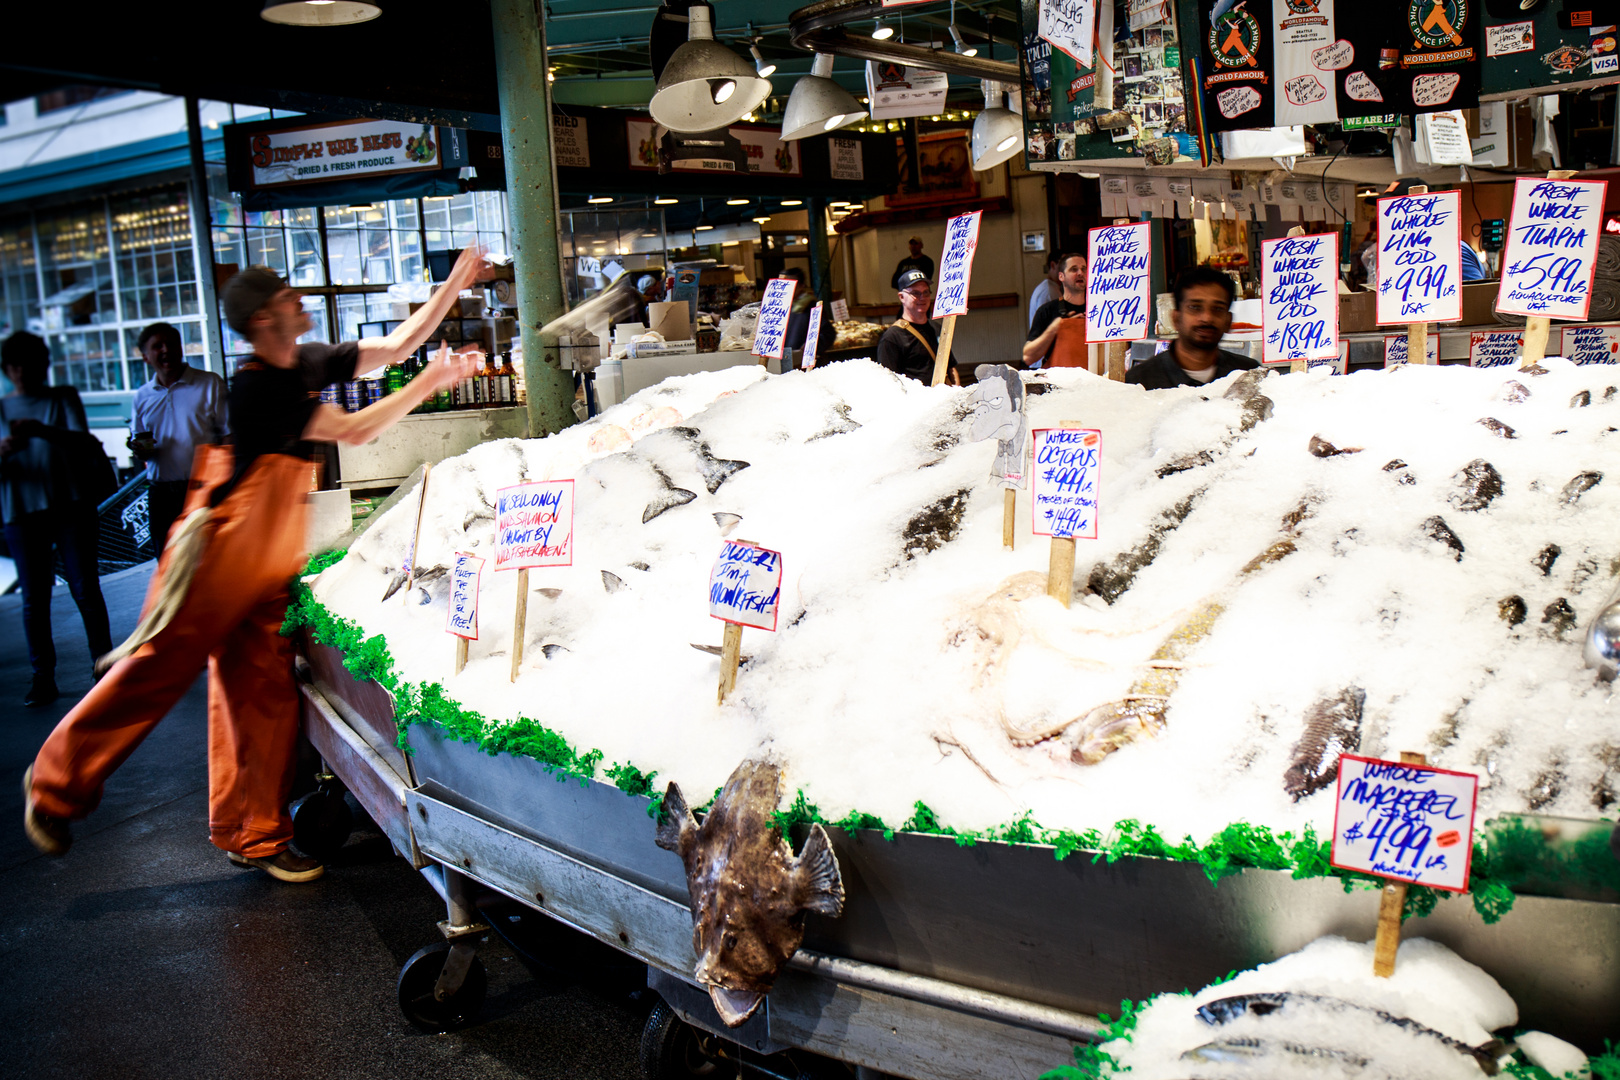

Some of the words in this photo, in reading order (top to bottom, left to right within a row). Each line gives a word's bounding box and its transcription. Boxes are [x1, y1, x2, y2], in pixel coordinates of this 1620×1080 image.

[1410, 5, 1418, 27] PIKE
[1414, 28, 1436, 46] PLACE
[1438, 30, 1456, 45] FISH
[1214, 49, 1234, 66] PLACE
[1236, 53, 1251, 65] FISH
[1248, 19, 1259, 53] MARKET
[1404, 54, 1435, 63] WORLD
[1436, 49, 1471, 60] FAMOUS
[1594, 58, 1618, 70] VISA
[1072, 76, 1092, 90] WORLD
[1208, 73, 1233, 82] WORLD
[1234, 71, 1264, 79] FAMOUS
[554, 116, 578, 128] RIED
[1346, 117, 1359, 125] WE
[1360, 115, 1383, 124] ARE
[1384, 113, 1395, 123] 12
[326, 138, 359, 157] THE
[362, 132, 403, 152] BEST
[555, 137, 577, 146] PPLES
[834, 138, 857, 149] FRESH
[298, 164, 321, 175] DRIED
[323, 164, 329, 172] &
[330, 162, 356, 172] FRESH
[357, 156, 395, 168] PRODUCE
[557, 156, 587, 166] ETABLES
[703, 161, 719, 169] DRIED
[1529, 182, 1590, 201] FRESH
[1384, 196, 1446, 217] FRESH
[1528, 202, 1590, 219] WHOLE
[950, 216, 973, 231] FRESH
[1391, 211, 1453, 231] WHOLE
[951, 228, 972, 240] WHOLE
[1095, 226, 1138, 243] FRESH
[1382, 229, 1432, 252] LING
[1515, 221, 1588, 248] TILAPIA
[951, 239, 966, 251] WILD
[1097, 241, 1140, 257] WHOLE
[1269, 237, 1324, 258] FRESH
[944, 248, 966, 264] KING
[1091, 252, 1149, 276] ALASKAN
[1394, 248, 1437, 266] COD
[1272, 256, 1324, 273] WHOLE
[943, 268, 966, 283] SALMON
[1278, 272, 1314, 289] WILD
[768, 279, 790, 291] FRESH
[1089, 274, 1149, 295] HALIBUT
[767, 291, 788, 299] WHOLE
[1269, 283, 1328, 305] BLACK
[1507, 290, 1584, 304] AQUACULTURE
[760, 304, 790, 318] ALASKAN
[768, 299, 783, 307] WILD
[1401, 302, 1431, 316] USA
[1526, 302, 1551, 311] USA
[1087, 295, 1141, 329] $18.99
[1277, 302, 1318, 321] COD
[761, 315, 783, 326] SILVER
[759, 326, 785, 337] SALMON
[1105, 327, 1128, 338] USA
[1267, 320, 1326, 353] $18.99
[1487, 332, 1522, 344] ALASKAN
[1566, 328, 1604, 336] JUMBO
[1573, 335, 1608, 345] WHITE
[1575, 342, 1608, 352] PRAWNS
[1287, 350, 1306, 359] USA
[1476, 348, 1518, 357] SCALLOPS
[1046, 430, 1089, 445] WHOLE
[1038, 445, 1098, 468] OCTOPUS
[1042, 467, 1087, 494] $9.99
[508, 494, 529, 510] SELL
[528, 490, 563, 518] ONLY
[1037, 493, 1062, 505] PIECES
[1063, 496, 1074, 505] OF
[499, 515, 515, 532] WILD
[514, 505, 564, 526] SALMON
[500, 529, 534, 546] CAUGHT
[534, 524, 553, 548] BY
[496, 549, 512, 566] WILD
[720, 543, 778, 572] CLOSER!
[454, 566, 477, 578] FILLET
[739, 570, 750, 586] A
[456, 579, 468, 591] THE
[453, 590, 468, 603] FISH
[710, 582, 780, 614] MONKFISH!
[450, 610, 475, 630] FREE!
[1363, 762, 1435, 784] WHOLE
[1342, 777, 1466, 820] MACKEREL
[1342, 815, 1433, 868] $4.99
[1371, 861, 1423, 882] NORWAY
